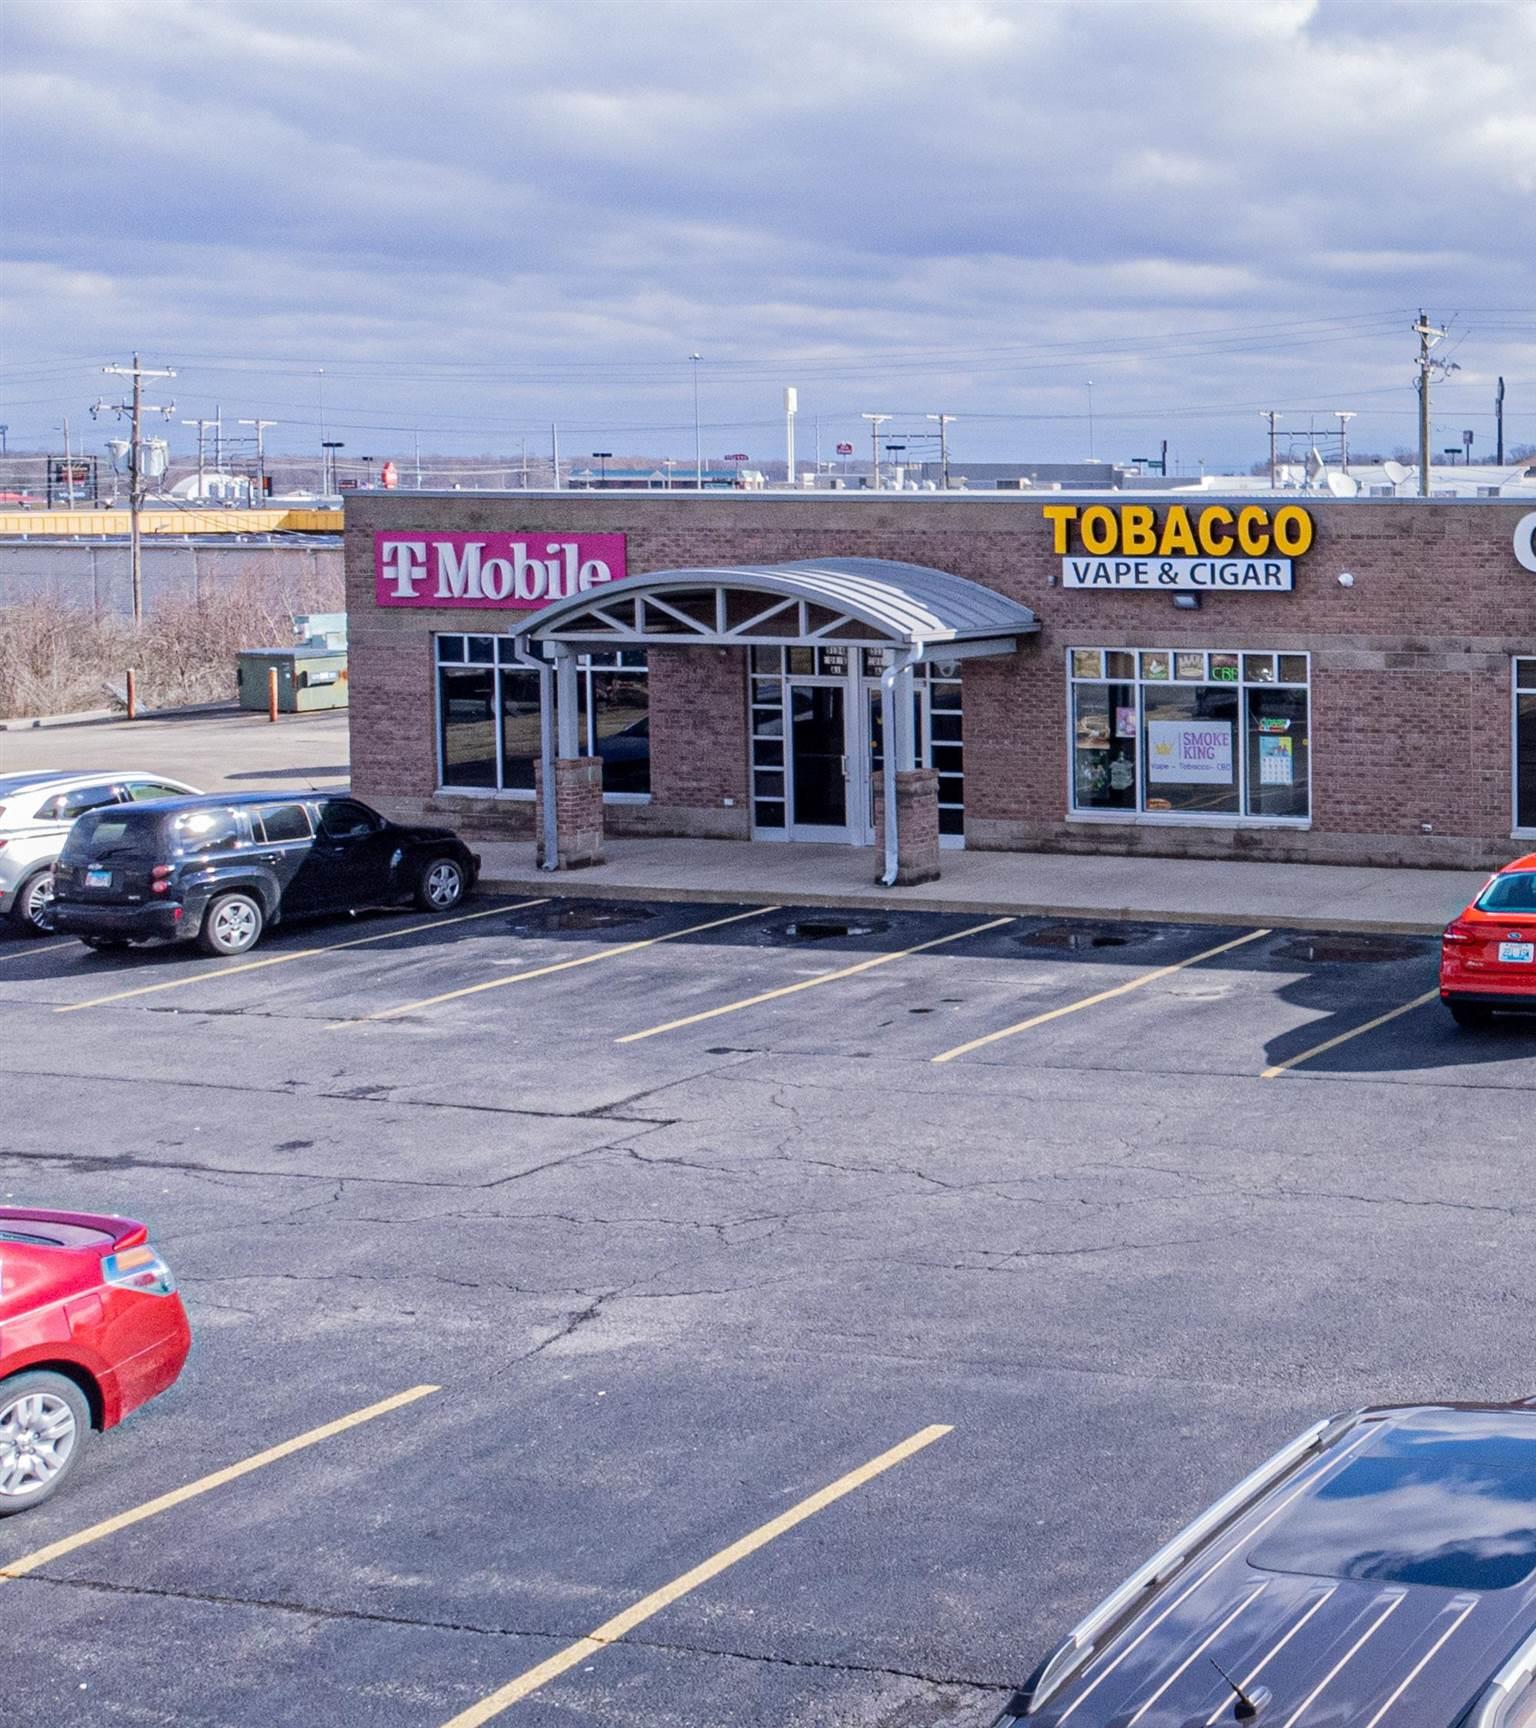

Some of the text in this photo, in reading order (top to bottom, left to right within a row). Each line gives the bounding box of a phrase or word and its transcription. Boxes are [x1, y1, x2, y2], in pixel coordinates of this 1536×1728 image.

[1042, 505, 1314, 557] TOBACCO
[1072, 561, 1283, 586] VAPE & CIGAR
[1183, 731, 1230, 746] SMOKE
[1183, 746, 1216, 760] KING
